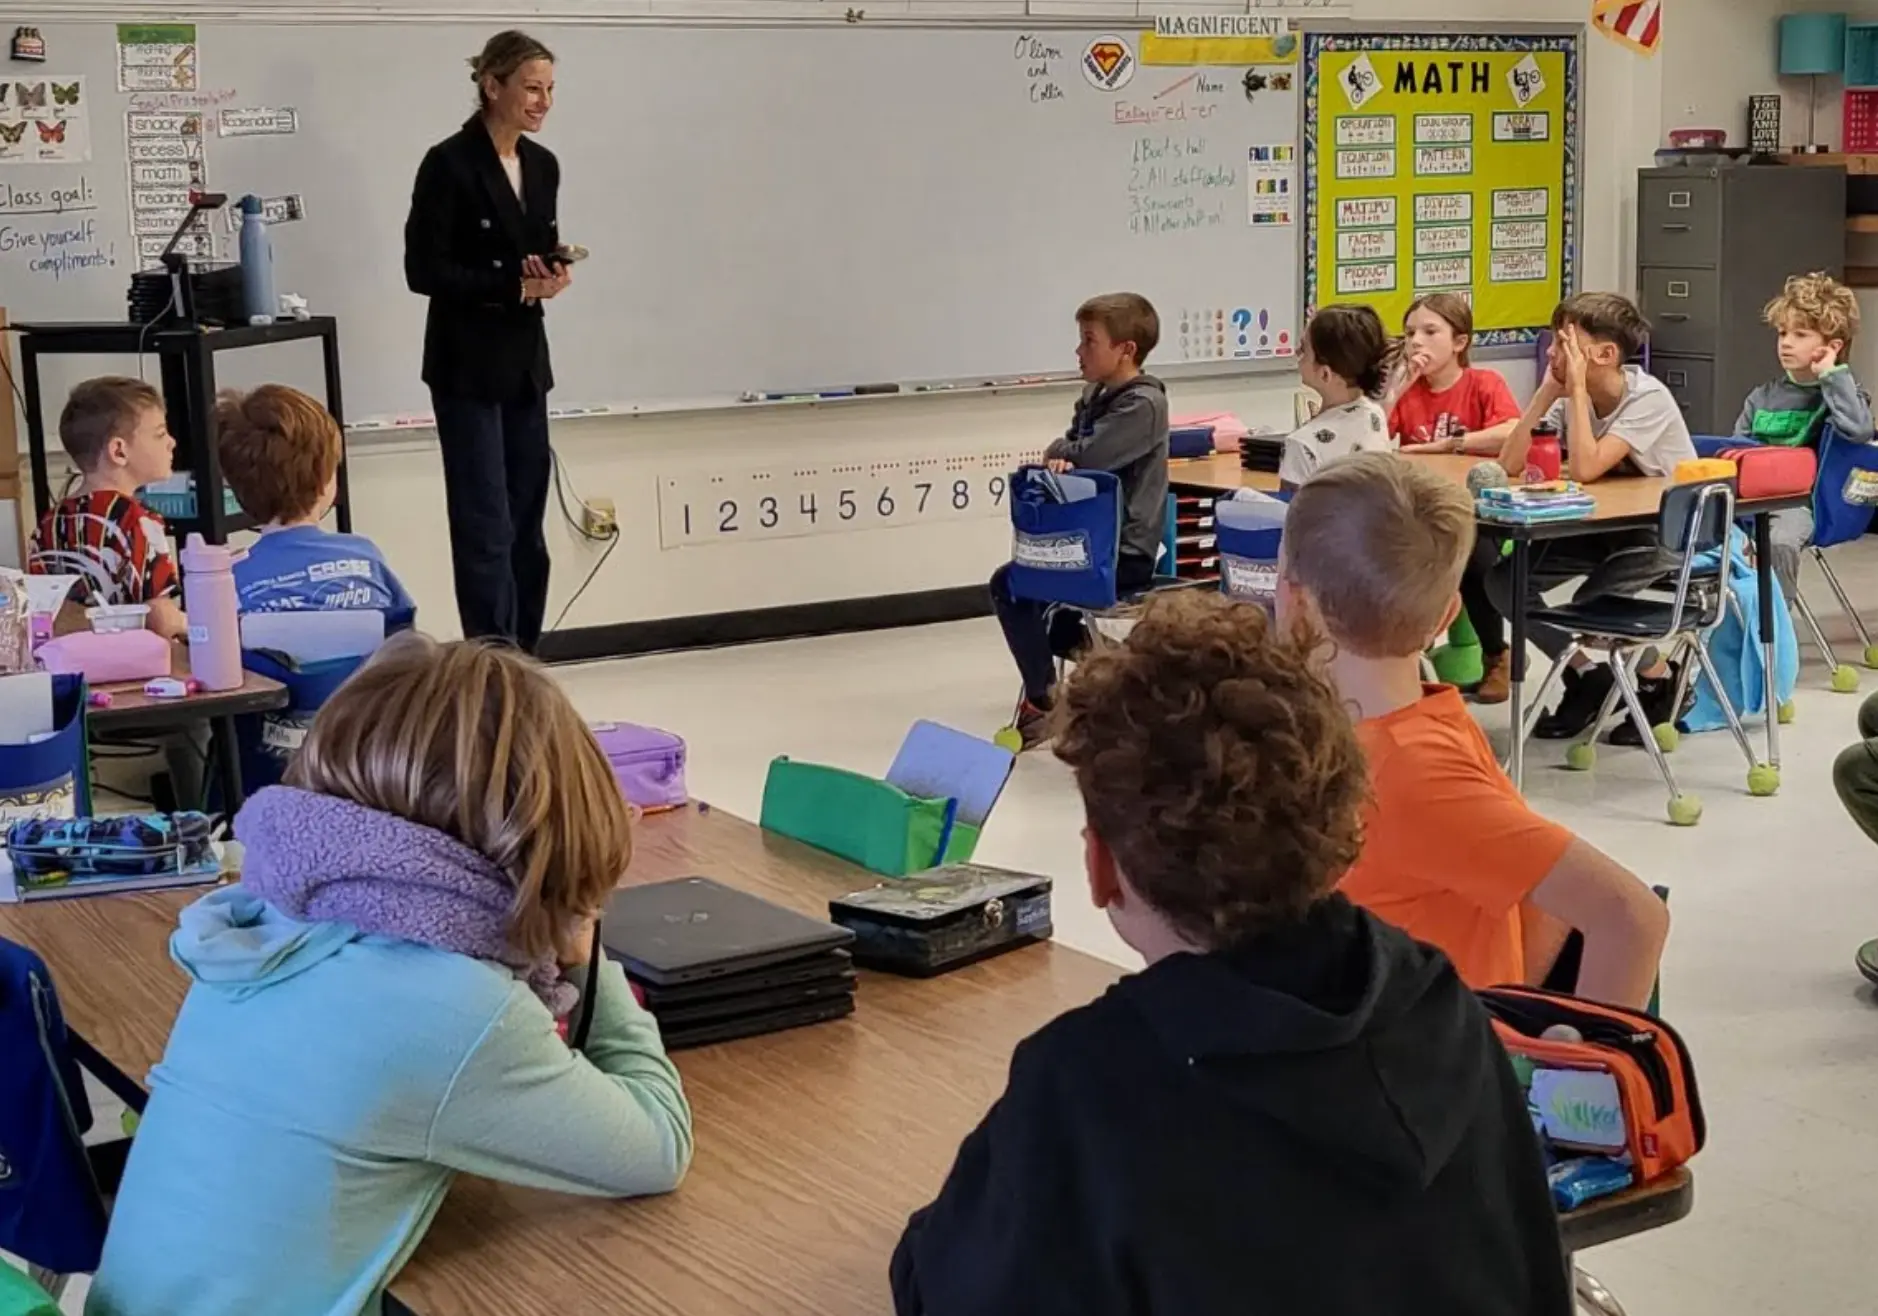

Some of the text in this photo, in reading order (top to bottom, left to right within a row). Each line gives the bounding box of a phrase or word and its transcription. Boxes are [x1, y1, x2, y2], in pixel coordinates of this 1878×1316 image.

[1158, 15, 1283, 35] MAGNIFICENT
[1196, 73, 1225, 94] Name
[1393, 61, 1491, 94] MATH
[1753, 109, 1778, 120] LOVE
[135, 117, 178, 131] snack
[1753, 120, 1778, 129] AND
[1752, 129, 1778, 140] LOVE
[133, 144, 184, 157] recess
[1341, 151, 1390, 164] EQUATION
[1420, 148, 1466, 162] PATTERN
[142, 166, 182, 180] math
[51, 175, 93, 214] goal:
[139, 192, 187, 207] reading
[1424, 196, 1463, 209] DIVIDE
[0, 218, 96, 256] Give yourself
[1348, 233, 1386, 246] FACTOR
[1419, 228, 1468, 241] DIVIDEND
[29, 241, 116, 282] compliments!
[1422, 260, 1467, 274] DIVISOR
[1344, 265, 1389, 280] PRODUCT
[684, 476, 1006, 535] 1 2 3 4 5 6 7 8 9
